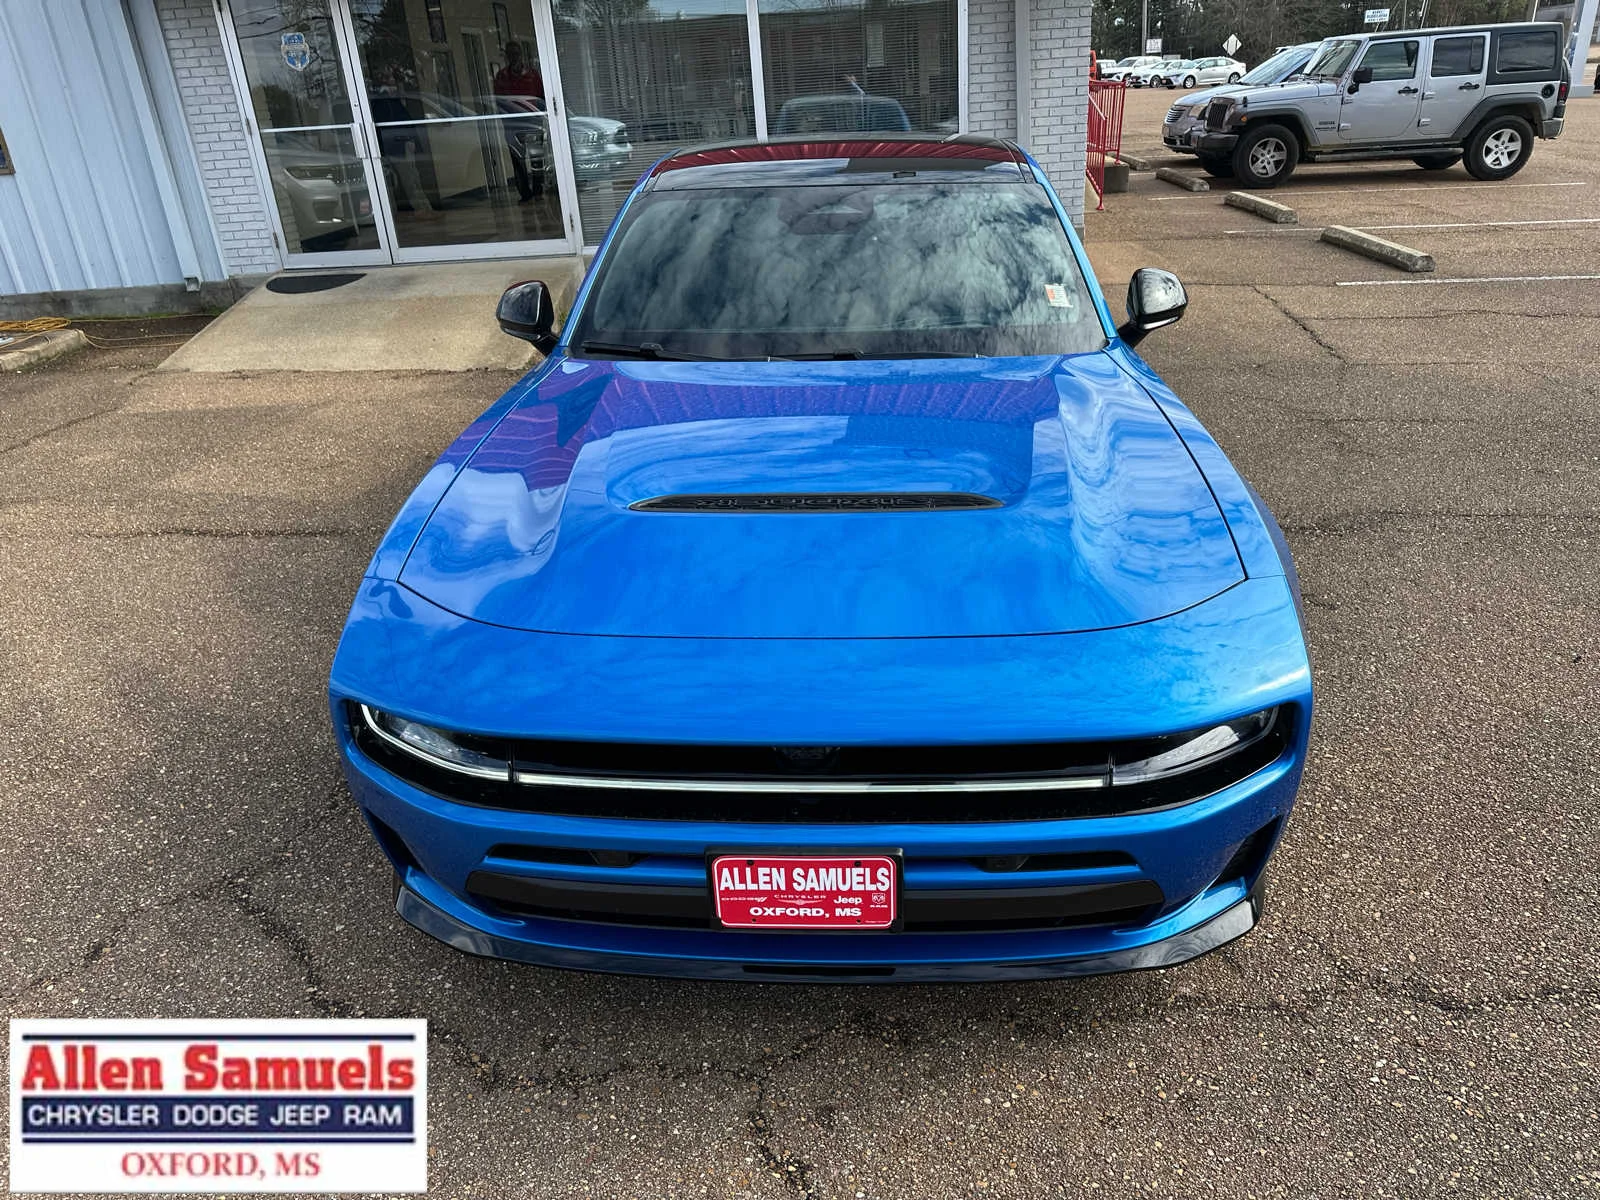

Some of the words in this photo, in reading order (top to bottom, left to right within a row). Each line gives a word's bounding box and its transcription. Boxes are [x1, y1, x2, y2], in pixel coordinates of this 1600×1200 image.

[720, 867, 785, 891] ALLEN
[793, 867, 890, 891] SAMUELS
[833, 895, 863, 905] Jeep
[749, 907, 830, 918] OXFORD,
[835, 907, 862, 917] MS
